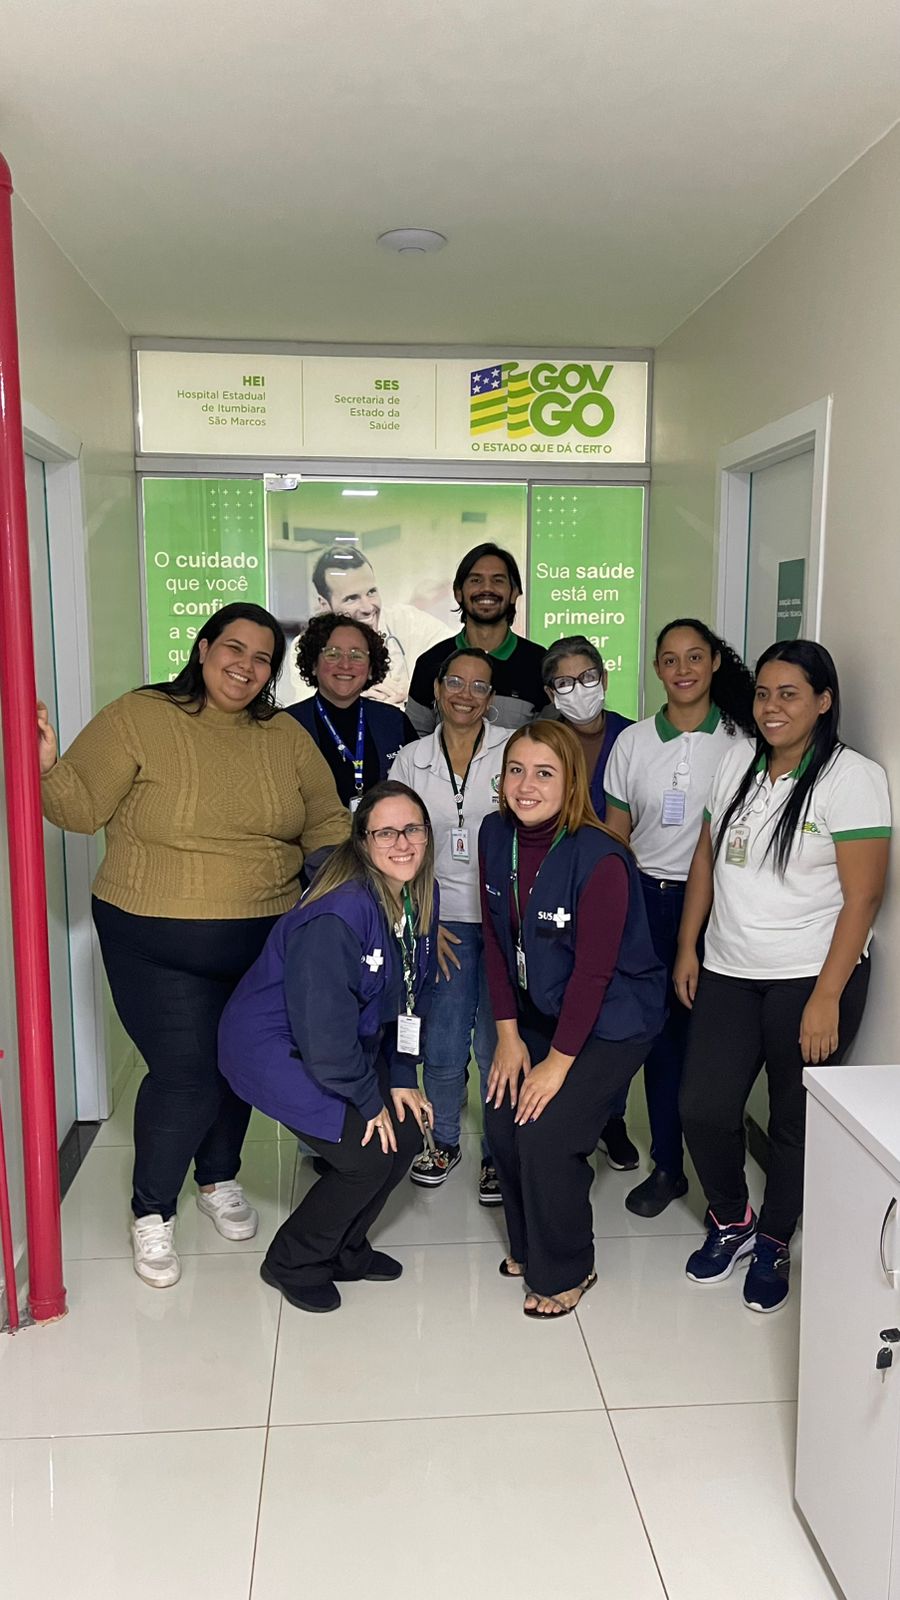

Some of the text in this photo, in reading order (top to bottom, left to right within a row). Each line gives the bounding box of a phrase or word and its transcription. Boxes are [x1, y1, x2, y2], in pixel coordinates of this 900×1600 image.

[243, 376, 265, 387] HEI
[530, 363, 614, 393] GOV
[375, 380, 400, 391] SES
[177, 390, 266, 402] Hospital Estadual
[334, 394, 400, 405] Secretaria de
[201, 403, 266, 414] de Itumbiara
[350, 407, 400, 418] Estado da
[530, 391, 615, 437] GO
[208, 416, 267, 427] São Marcos
[369, 420, 400, 431] Saúde
[471, 441, 612, 455] O ESTADO QUE DÁ CERTO
[154, 551, 259, 569] O cuidado
[536, 563, 635, 580] Sua saúde
[165, 575, 249, 595] que você
[551, 585, 619, 602] está em
[173, 598, 224, 616] confi
[544, 608, 625, 629] primeiro
[169, 626, 180, 640] a
[537, 910, 554, 921] SUS
